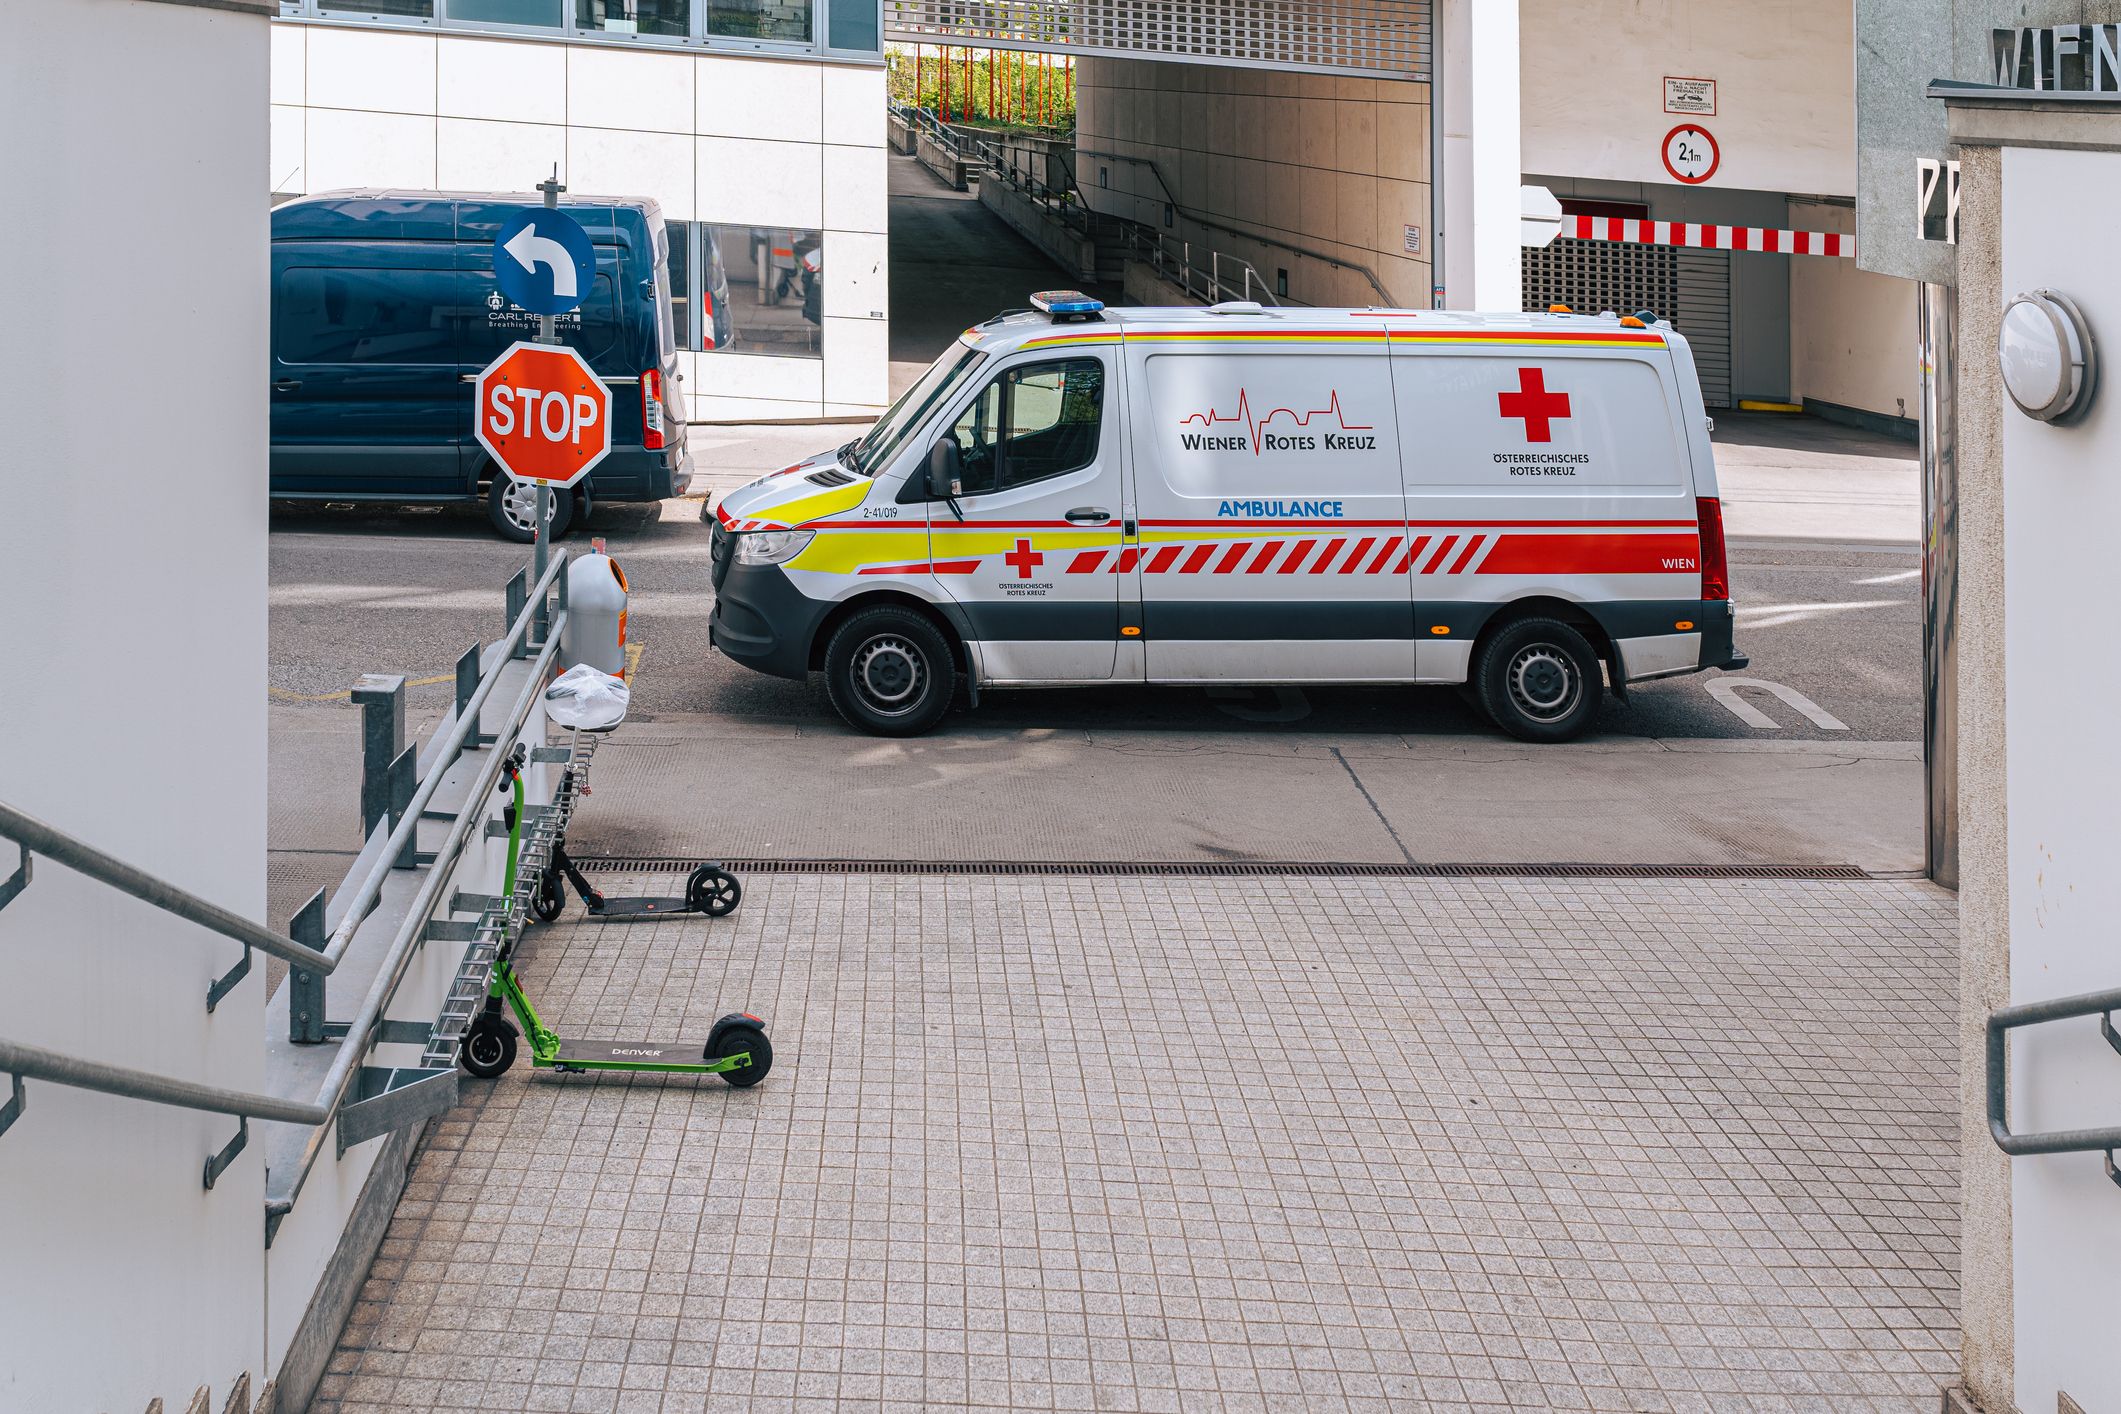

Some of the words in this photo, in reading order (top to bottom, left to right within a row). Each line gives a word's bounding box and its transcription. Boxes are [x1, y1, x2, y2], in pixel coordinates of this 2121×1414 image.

[488, 312, 522, 321] CARL
[524, 313, 571, 322] REER
[488, 321, 529, 330] Breathing
[532, 322, 581, 331] Eneering
[489, 384, 598, 445] STOP
[1493, 453, 1589, 463] ÖSTERREICHISCHES
[1510, 467, 1541, 476] ROTES
[1544, 467, 1576, 476] KREUZ
[863, 507, 898, 519] 2-41/019
[1218, 501, 1343, 518] AMBULANCE
[1662, 558, 1695, 569] WIEN
[612, 1048, 661, 1057] DENVER
